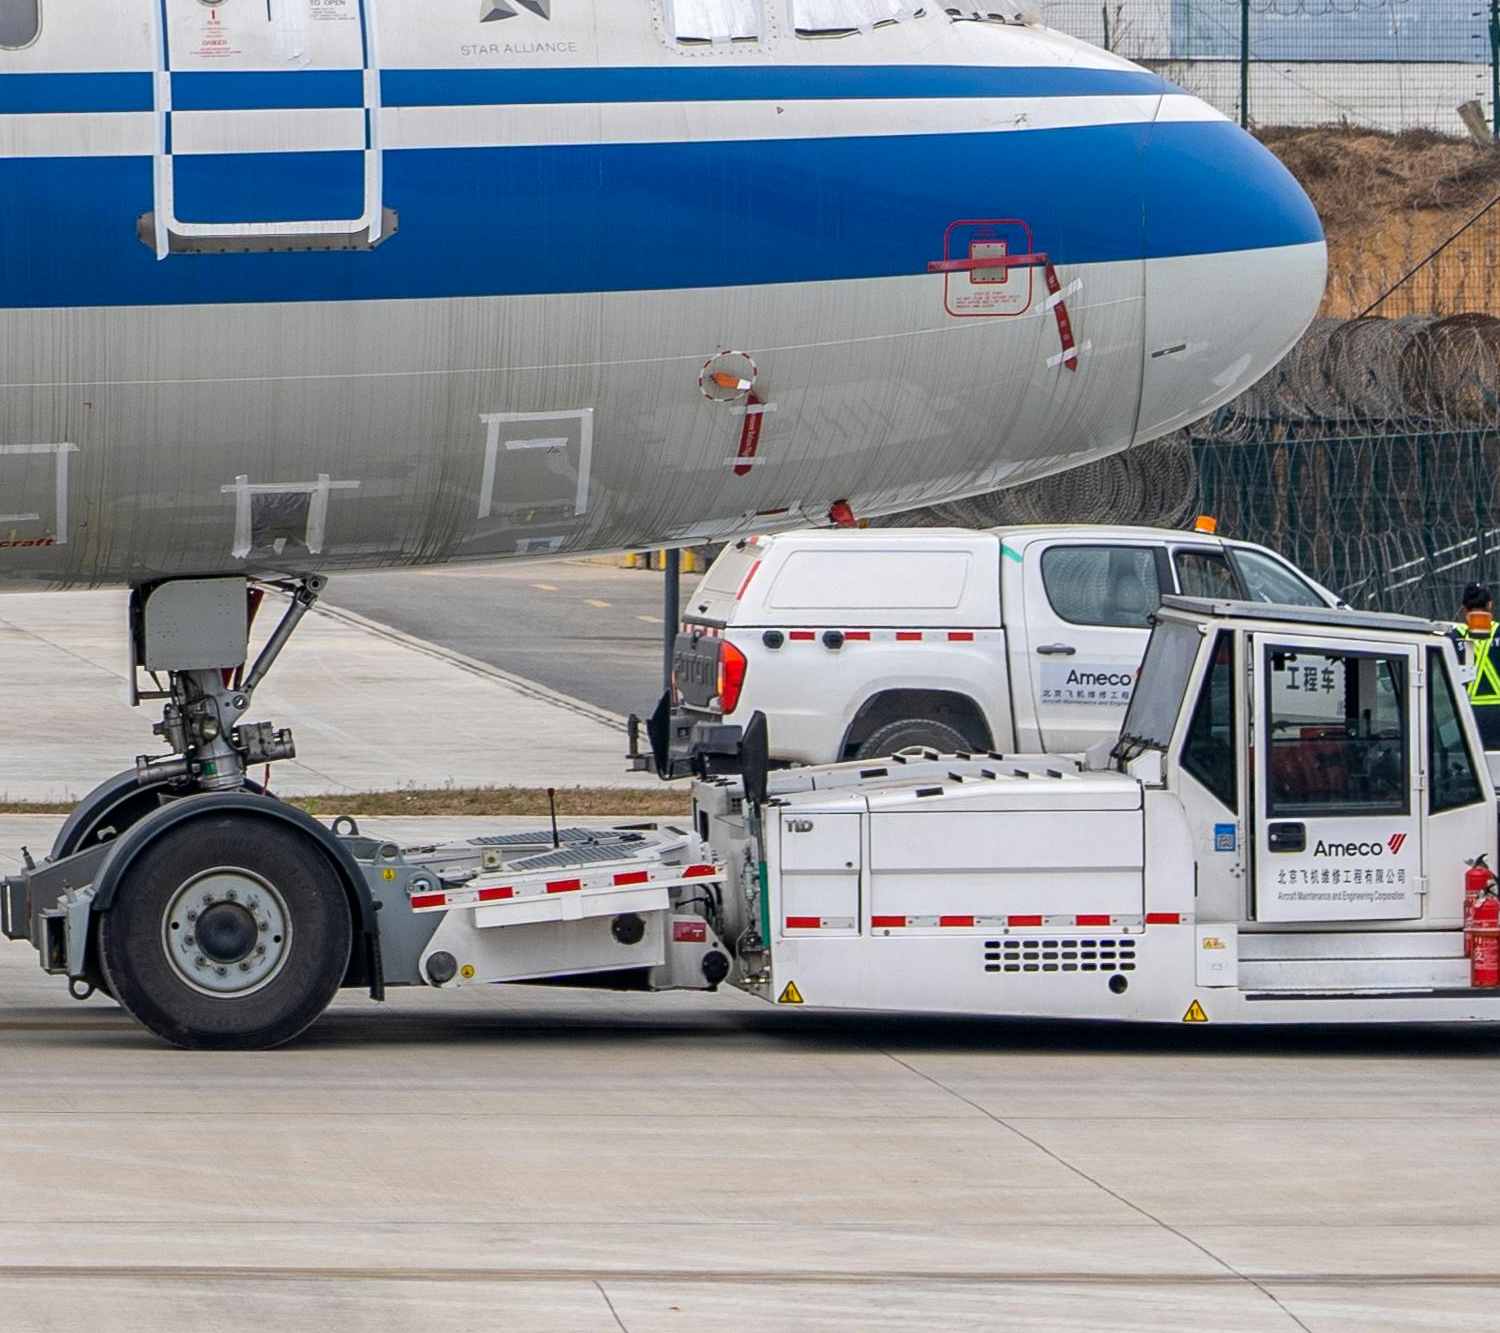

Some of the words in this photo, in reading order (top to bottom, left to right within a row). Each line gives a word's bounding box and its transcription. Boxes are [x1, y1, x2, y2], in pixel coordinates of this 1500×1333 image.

[461, 44, 499, 56] STAR
[504, 41, 577, 54] ALLIANCE
[1066, 669, 1131, 686] Ameco
[1286, 666, 1335, 693] 工程车
[785, 820, 814, 832] TLD
[1313, 839, 1383, 857] Ameco
[1278, 869, 1405, 884] 北京飞机维修工程有限公司
